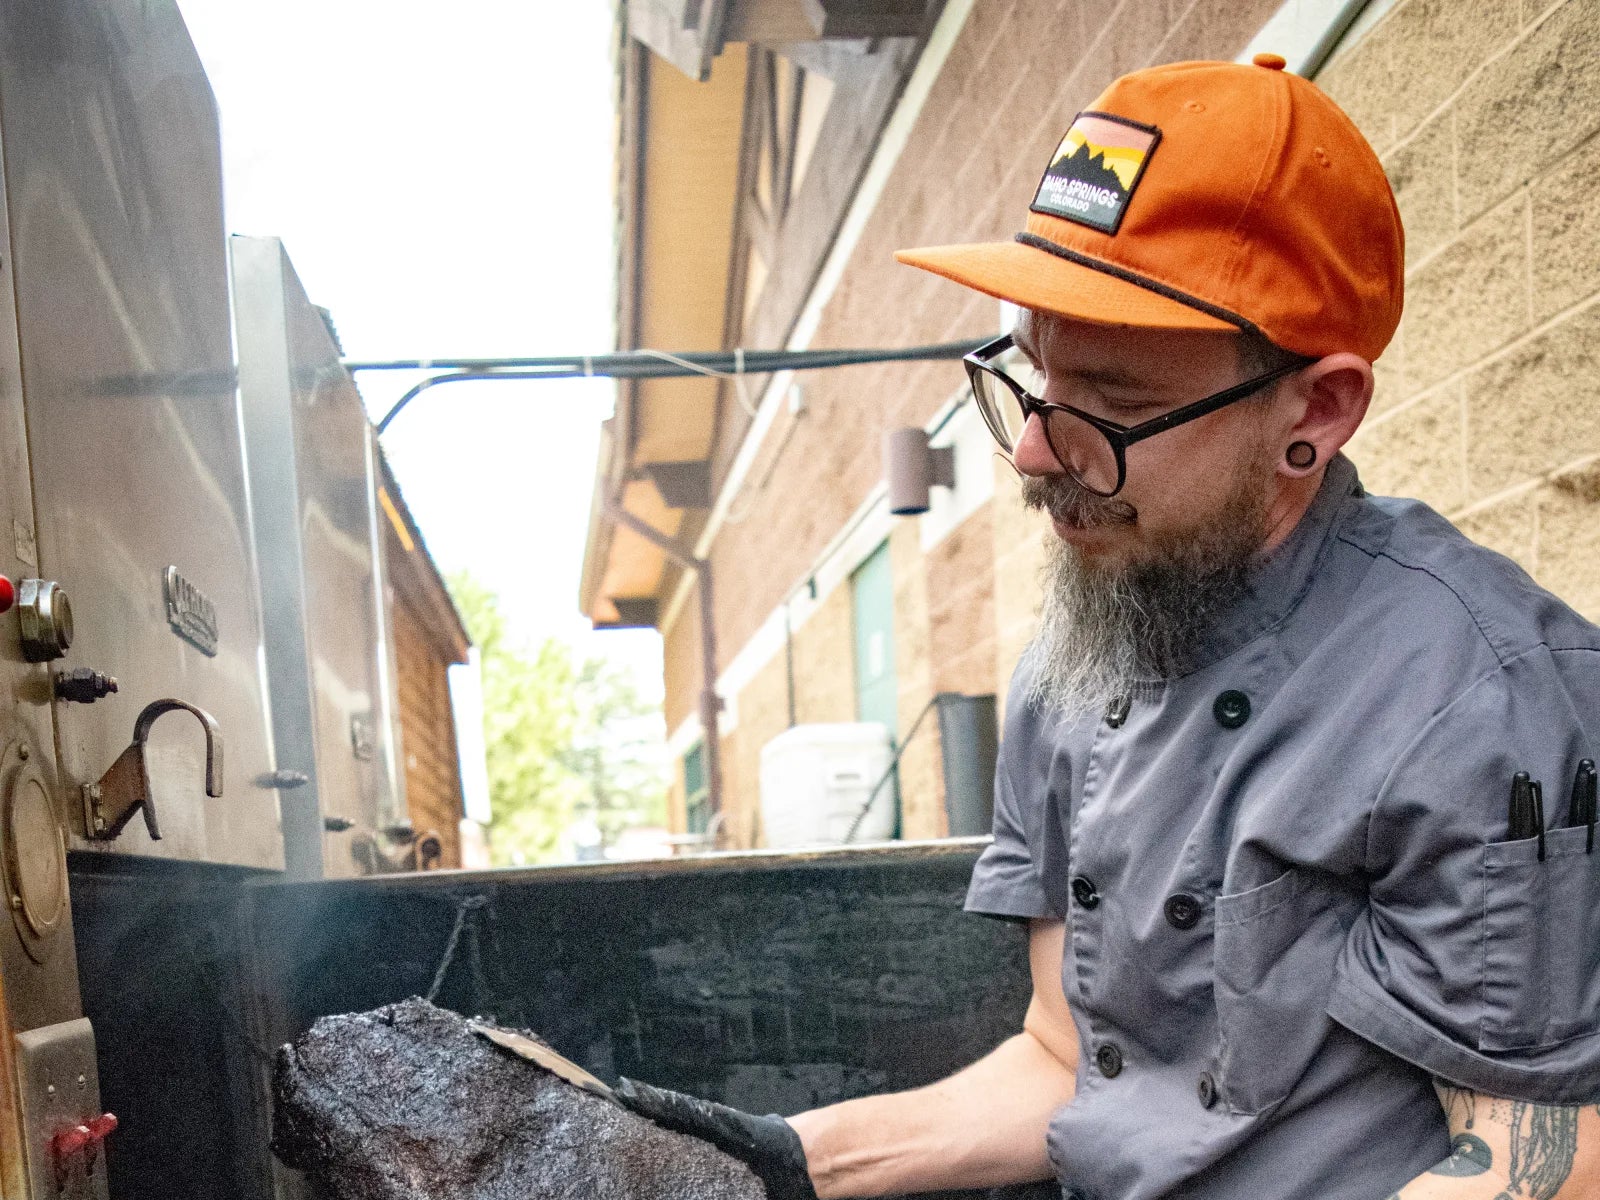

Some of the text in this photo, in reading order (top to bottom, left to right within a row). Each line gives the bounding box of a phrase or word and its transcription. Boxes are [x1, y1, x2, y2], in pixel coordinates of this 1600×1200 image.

[1042, 175, 1119, 209] DAHO SPRINGS
[1050, 192, 1090, 212] COLORADO
